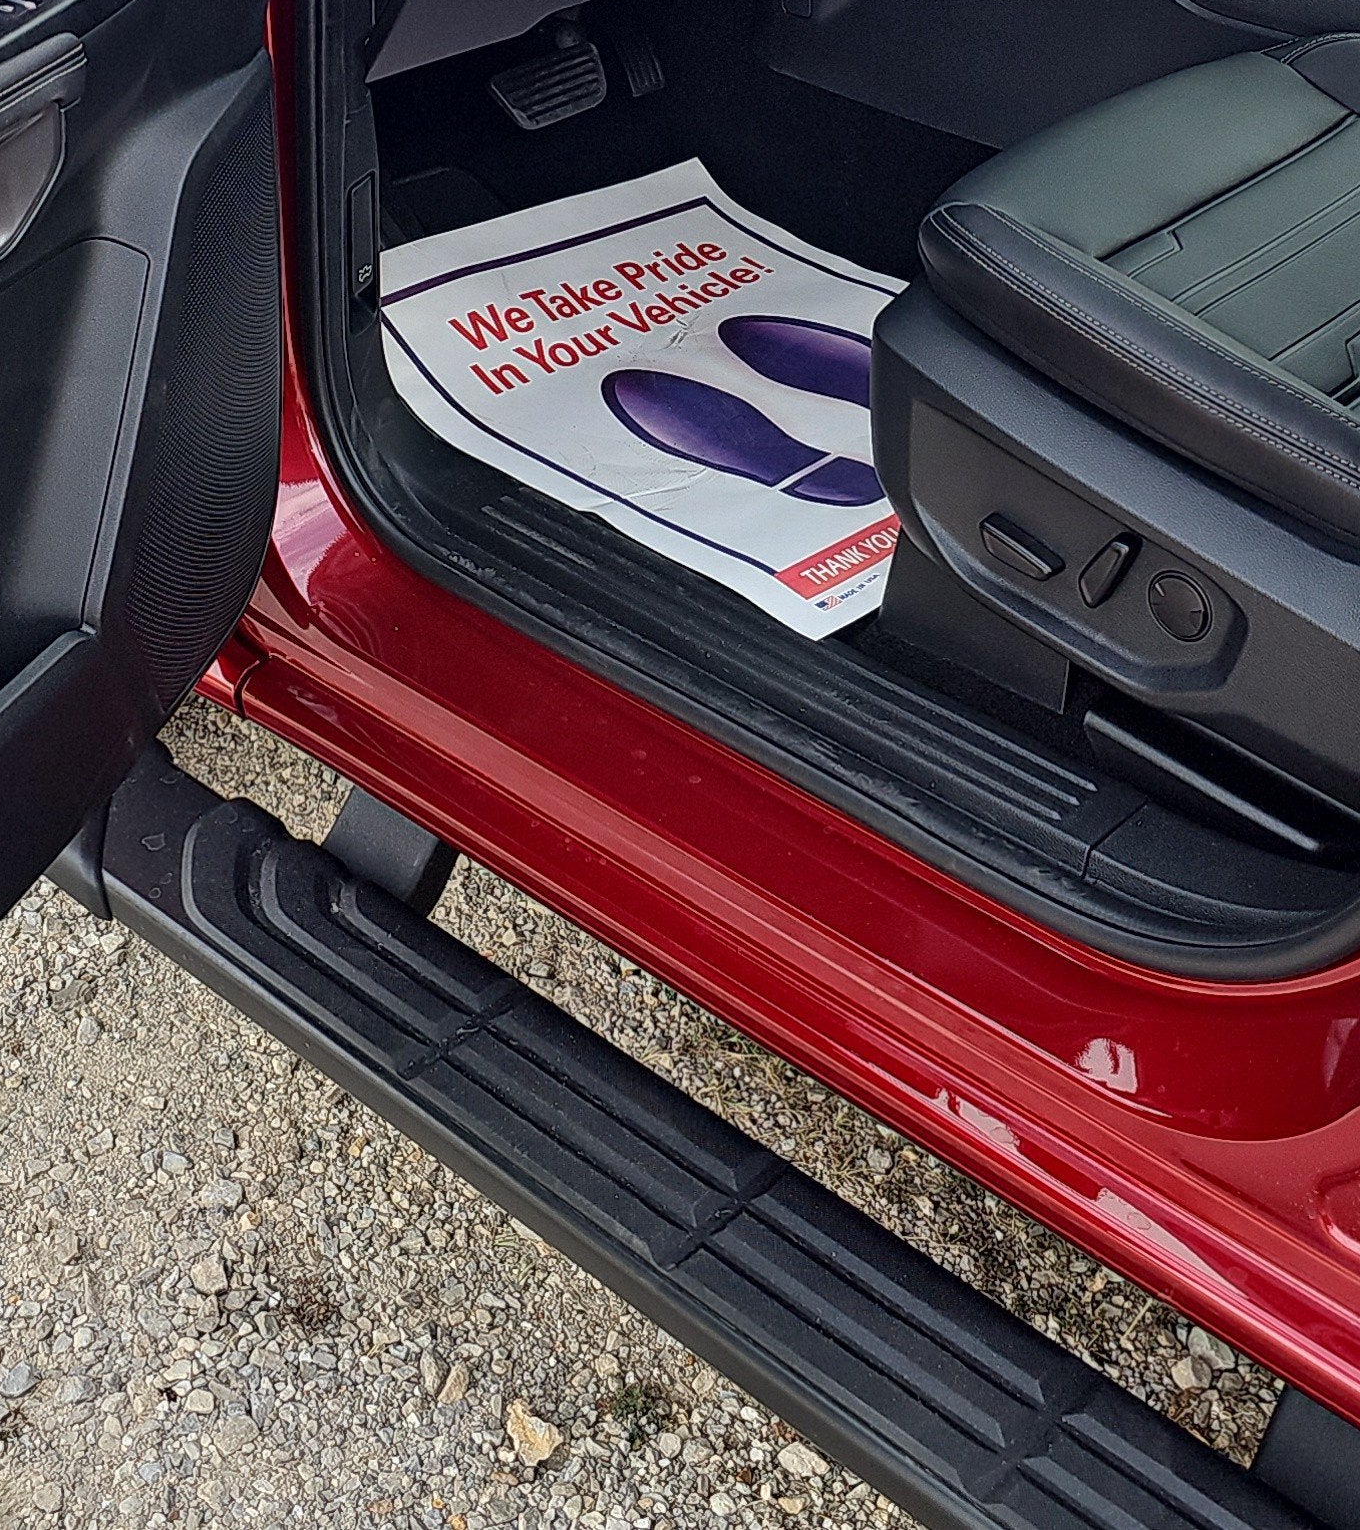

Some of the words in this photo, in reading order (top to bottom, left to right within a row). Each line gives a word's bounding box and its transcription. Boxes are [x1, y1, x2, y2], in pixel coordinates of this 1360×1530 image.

[448, 304, 534, 350] We
[518, 283, 622, 321] Take
[613, 242, 727, 290] Pride
[469, 364, 531, 394] In
[512, 325, 620, 374] Your
[606, 256, 774, 333] Vehicle!
[800, 545, 871, 585] THANK
[858, 527, 899, 553] YOU
[837, 588, 859, 600] MADE
[864, 574, 880, 583] USA
